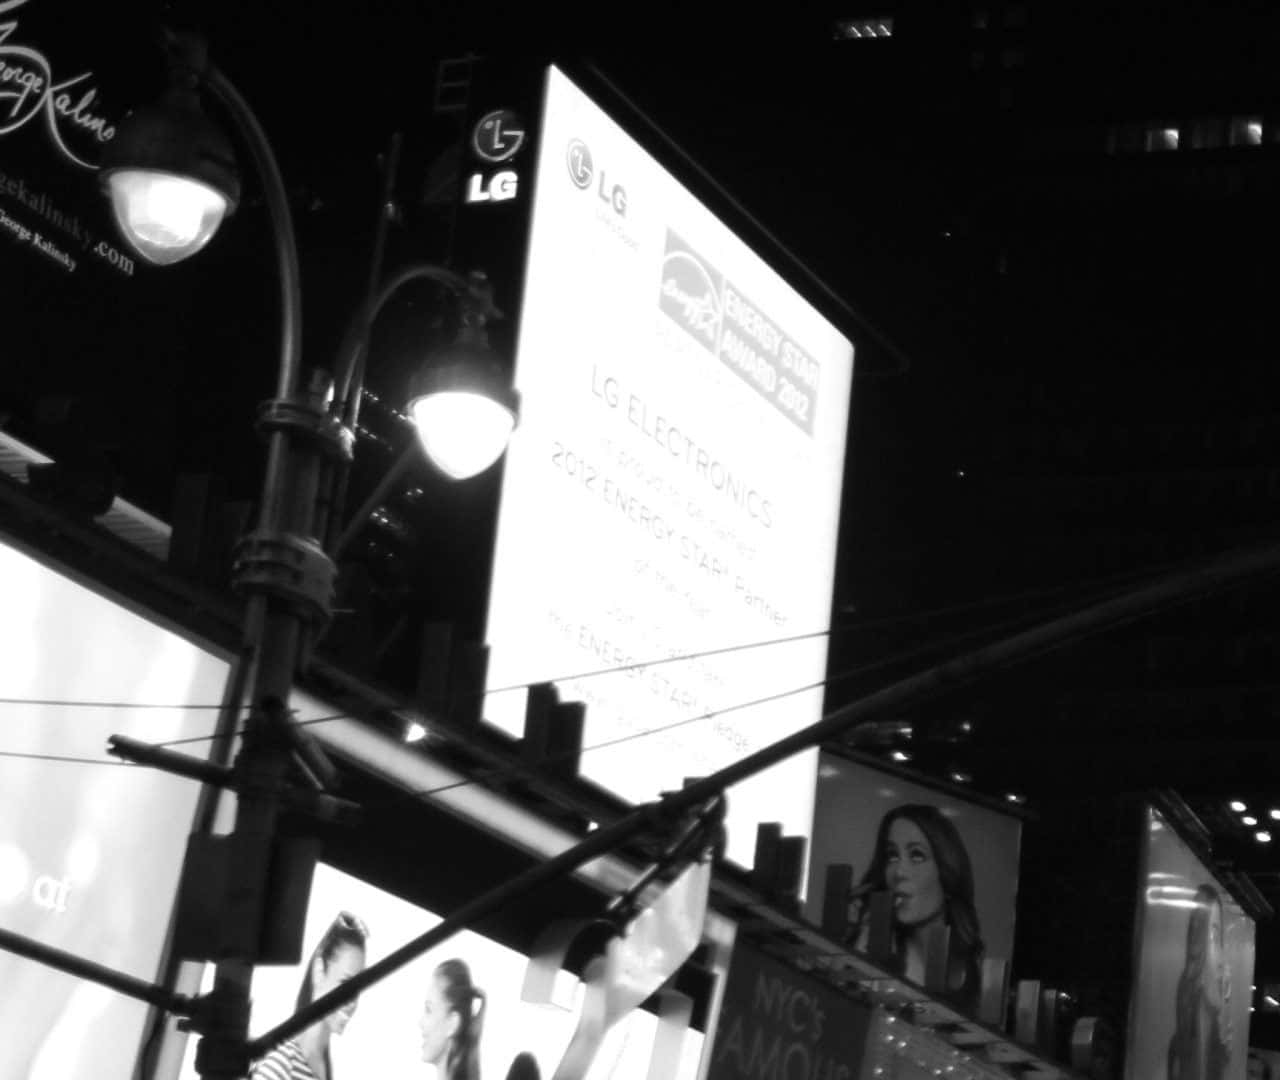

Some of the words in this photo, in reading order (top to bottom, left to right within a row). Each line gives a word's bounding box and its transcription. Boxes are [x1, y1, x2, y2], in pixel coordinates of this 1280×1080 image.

[467, 172, 519, 203] LG
[597, 169, 628, 219] LG
[591, 363, 620, 409] LG
[627, 393, 773, 529] ELECTRONICS
[551, 440, 599, 493] 2012
[604, 477, 677, 545] ENERGY
